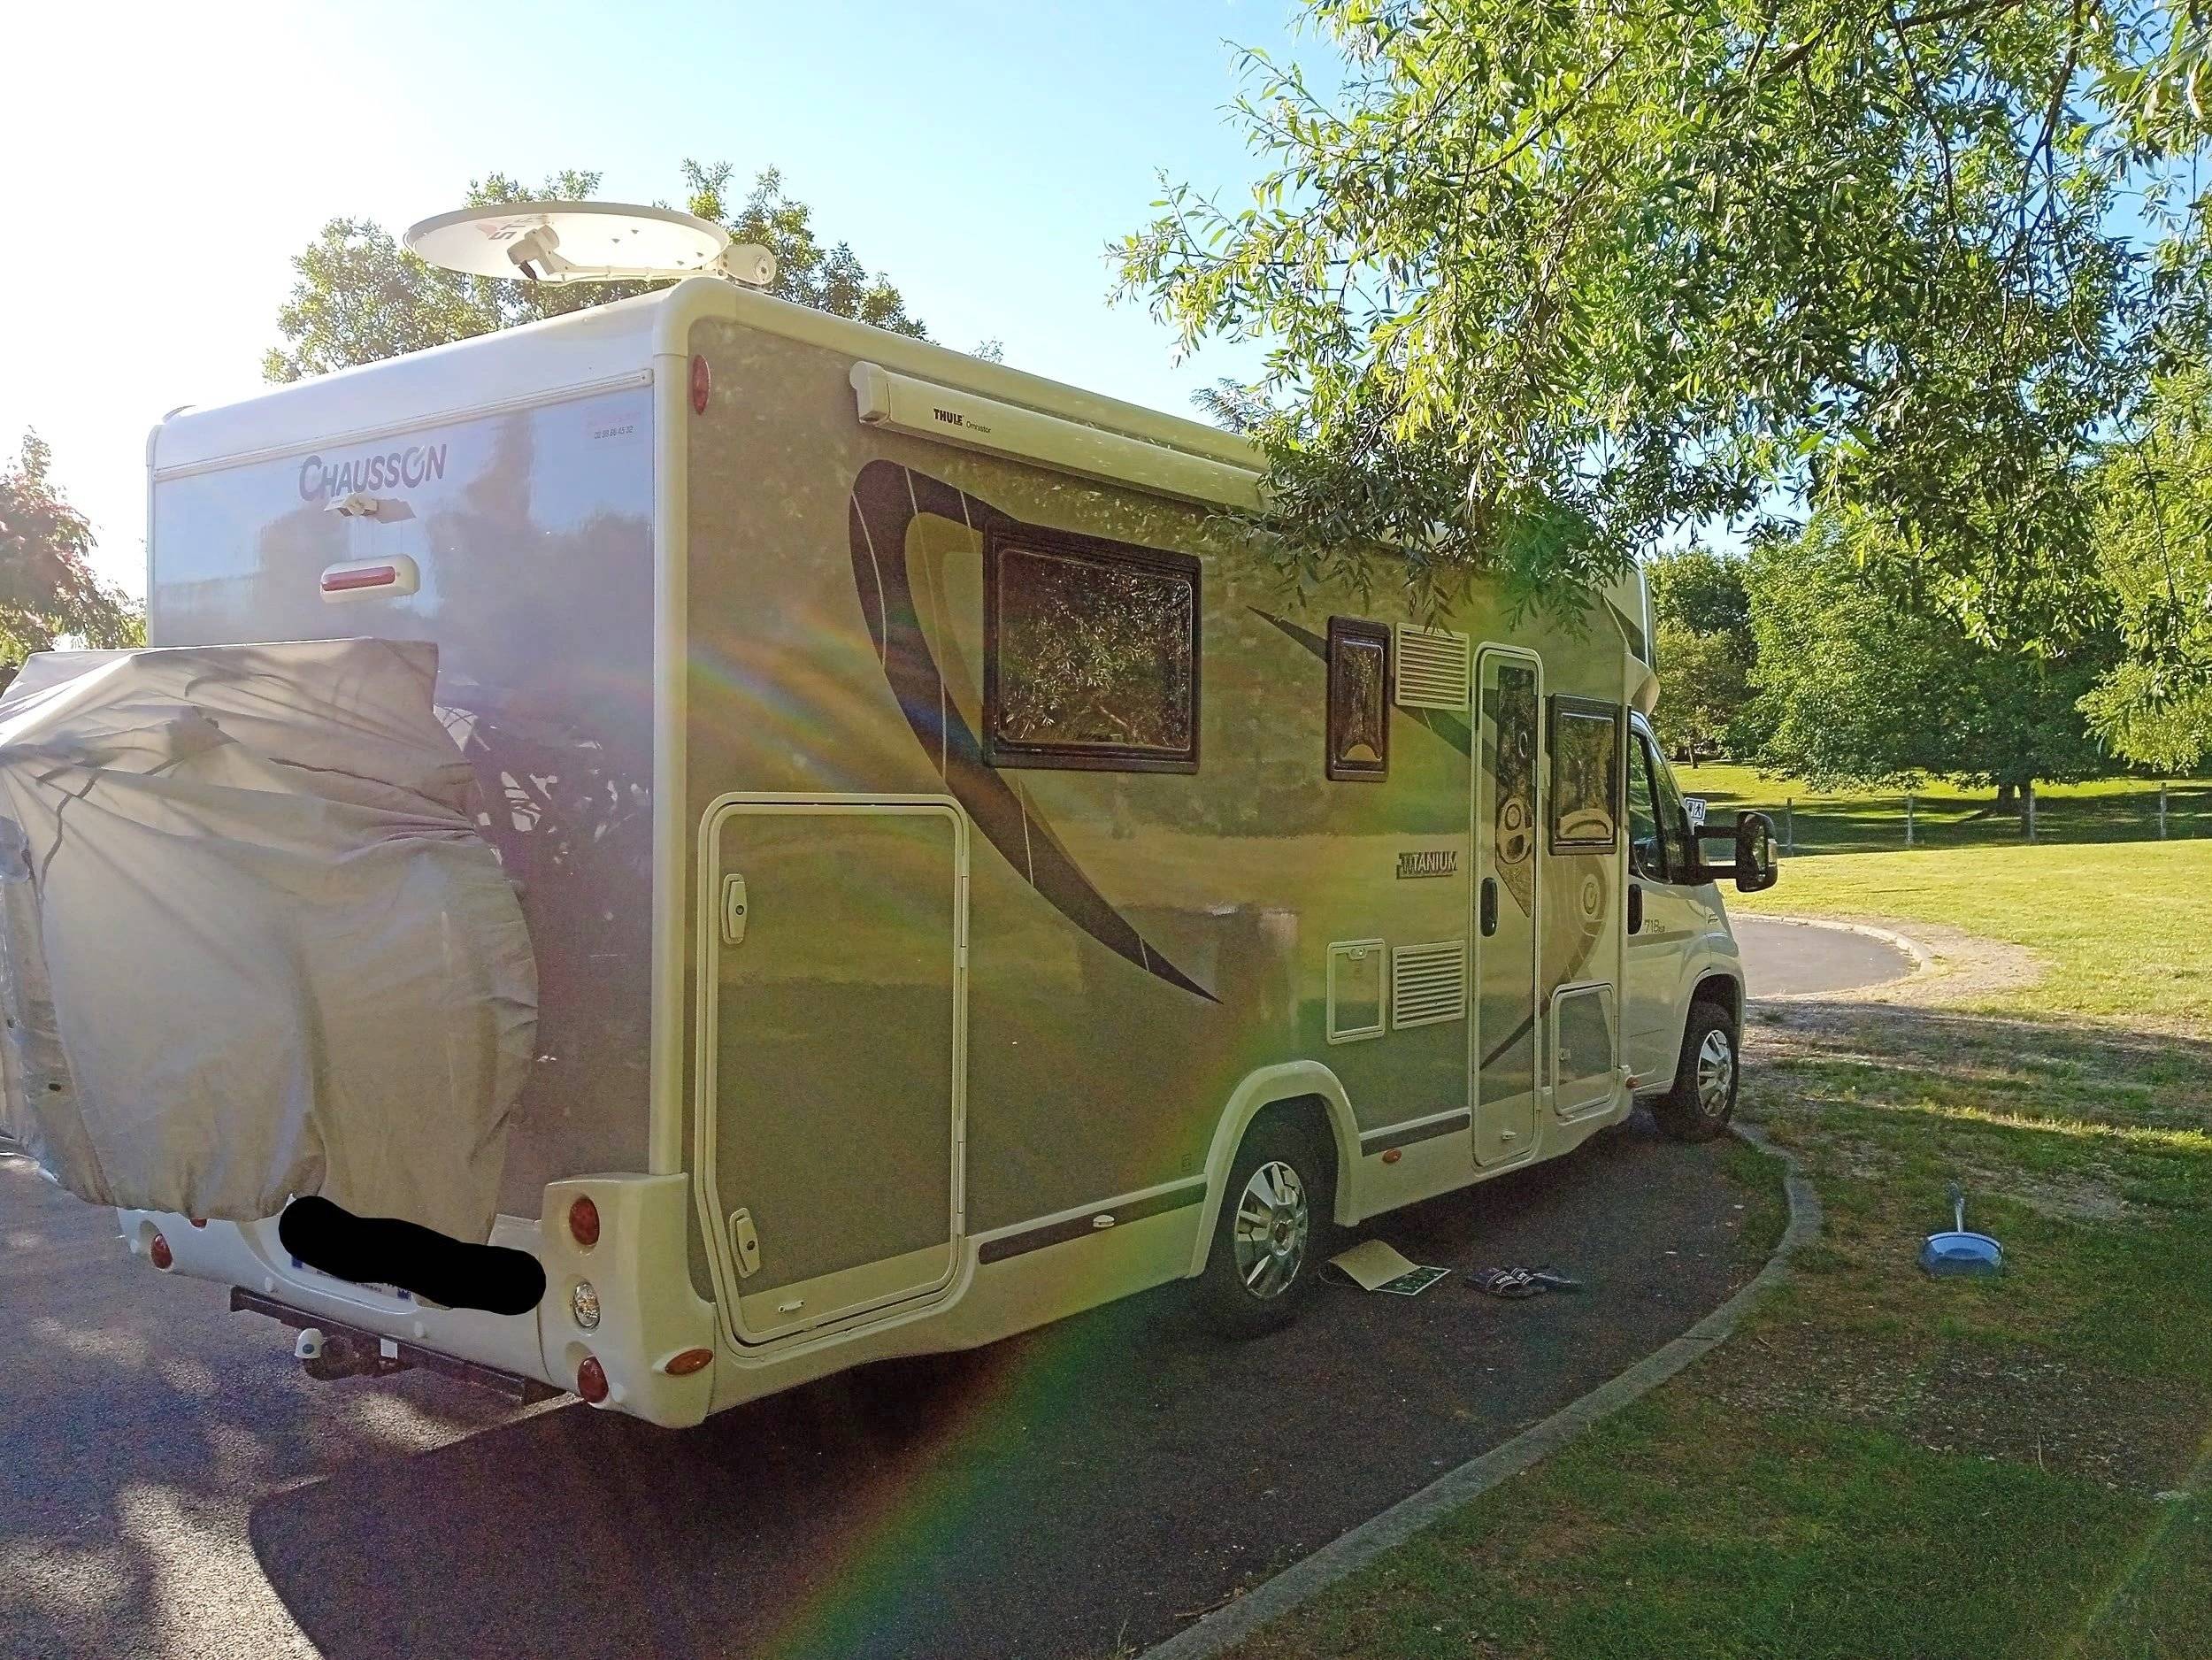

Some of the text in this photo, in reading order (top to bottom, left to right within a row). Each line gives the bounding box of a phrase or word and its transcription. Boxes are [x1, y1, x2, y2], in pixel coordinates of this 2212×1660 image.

[933, 408, 991, 434] THULE Omnistor
[299, 444, 447, 501] CHAUSSON
[1398, 851, 1458, 874] TITANIUM
